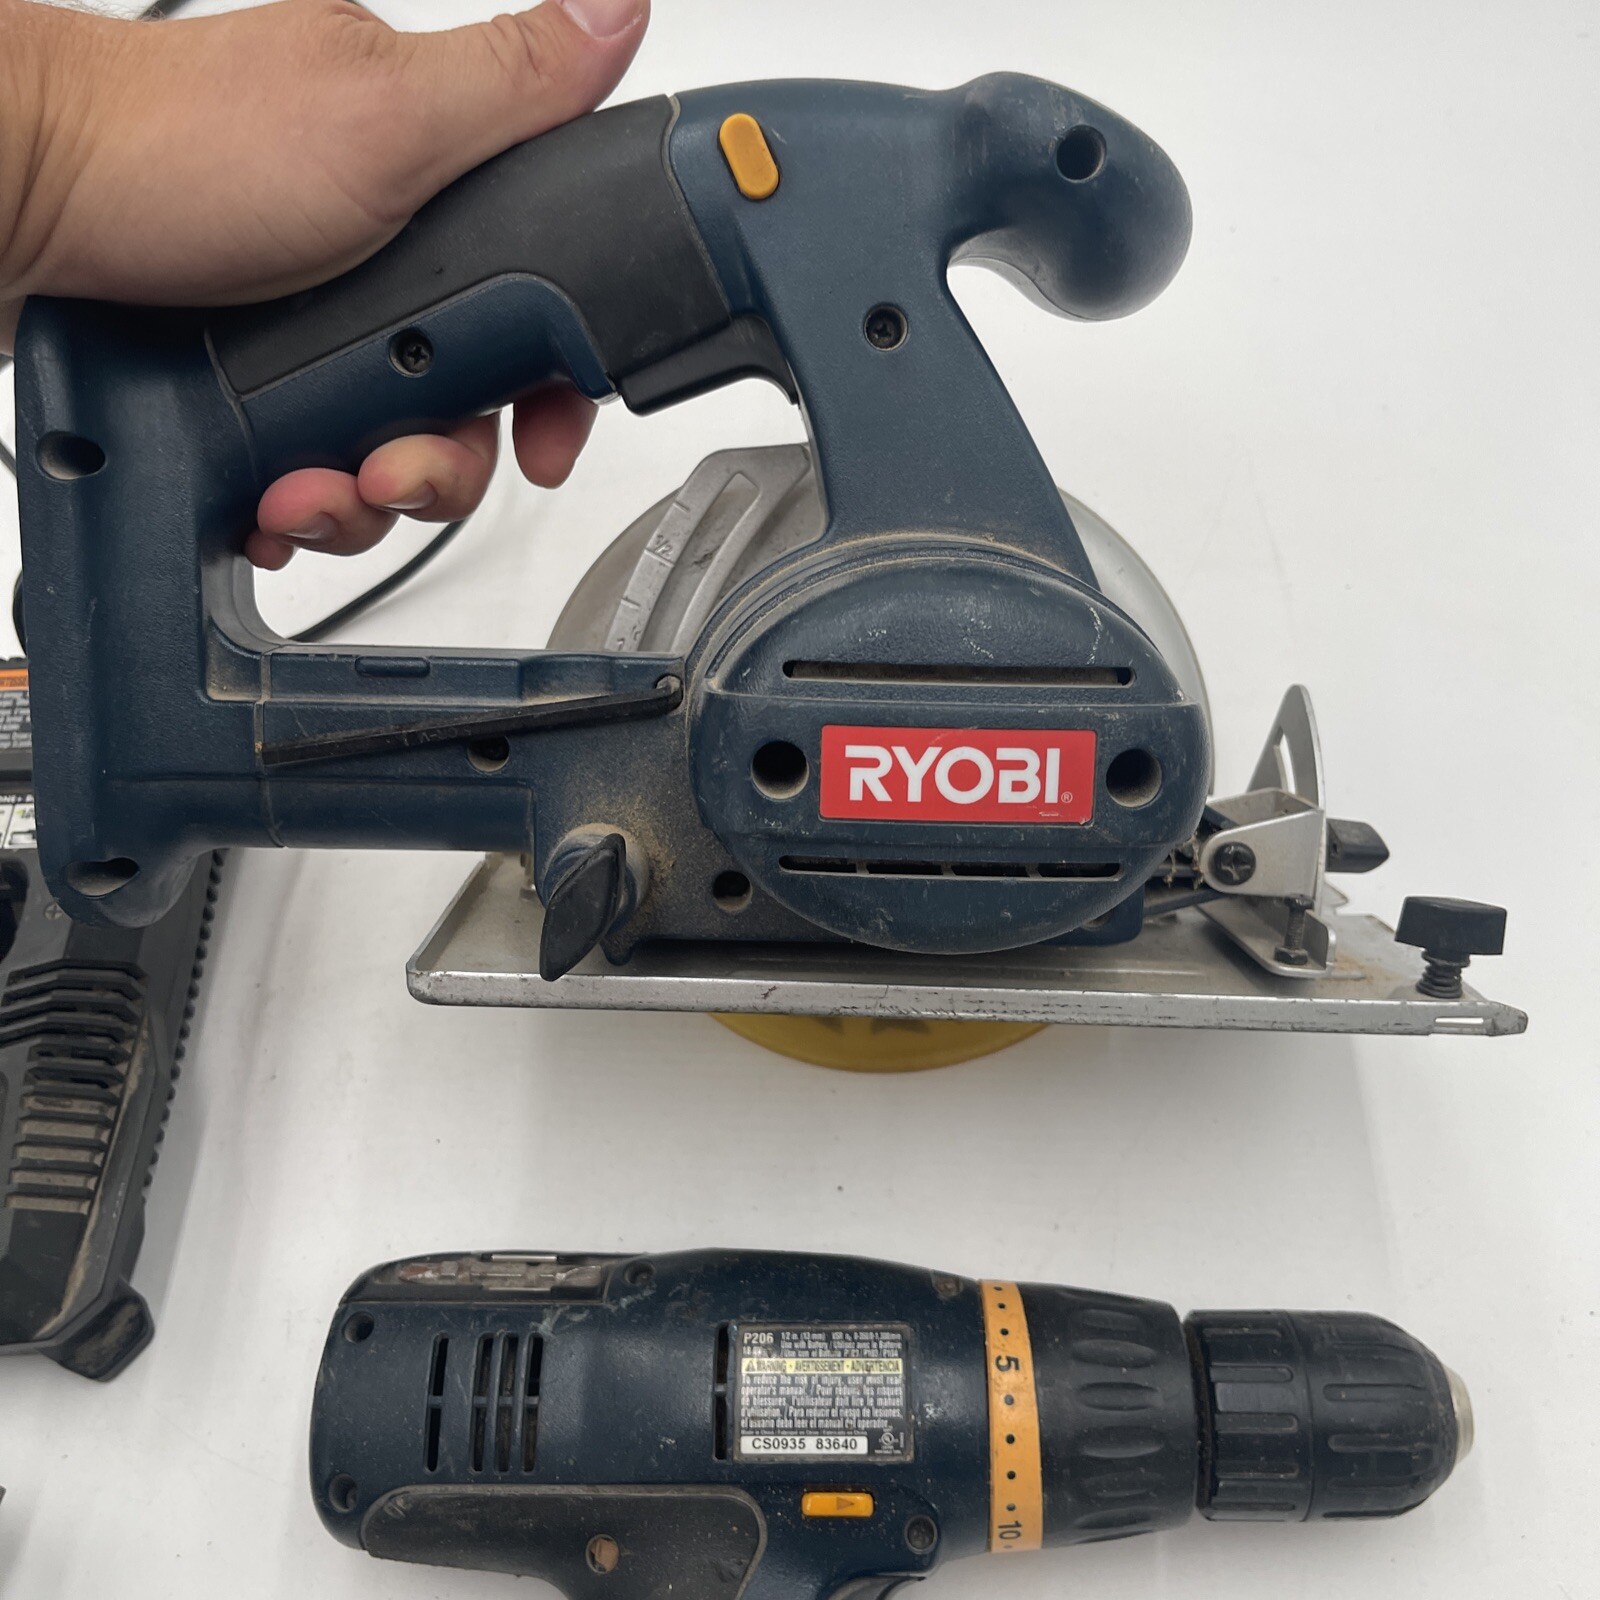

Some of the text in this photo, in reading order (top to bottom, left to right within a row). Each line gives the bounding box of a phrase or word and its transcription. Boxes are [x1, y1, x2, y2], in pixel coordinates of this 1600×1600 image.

[845, 745, 1061, 804] RYOBI
[744, 1333, 773, 1344] P206
[757, 1361, 899, 1372] WARNING AVERTISSEMENT ADVERTENCIA
[995, 1355, 1019, 1371] 5
[742, 1375, 750, 1384] To
[754, 1375, 776, 1384] reduce
[780, 1375, 791, 1384] the
[795, 1375, 807, 1384] risk
[811, 1375, 818, 1384] of
[848, 1375, 862, 1384] user
[866, 1375, 884, 1384] must
[852, 1396, 864, 1406] lire
[867, 1396, 874, 1406] le
[877, 1396, 902, 1406] manuel
[789, 1407, 804, 1417] Para
[832, 1407, 838, 1417] el
[862, 1407, 870, 1417] de
[795, 1419, 808, 1428] leer
[810, 1419, 816, 1428] el
[818, 1419, 843, 1428] manual
[752, 1438, 857, 1449] CS0935 83640
[998, 1521, 1021, 1540] 10
